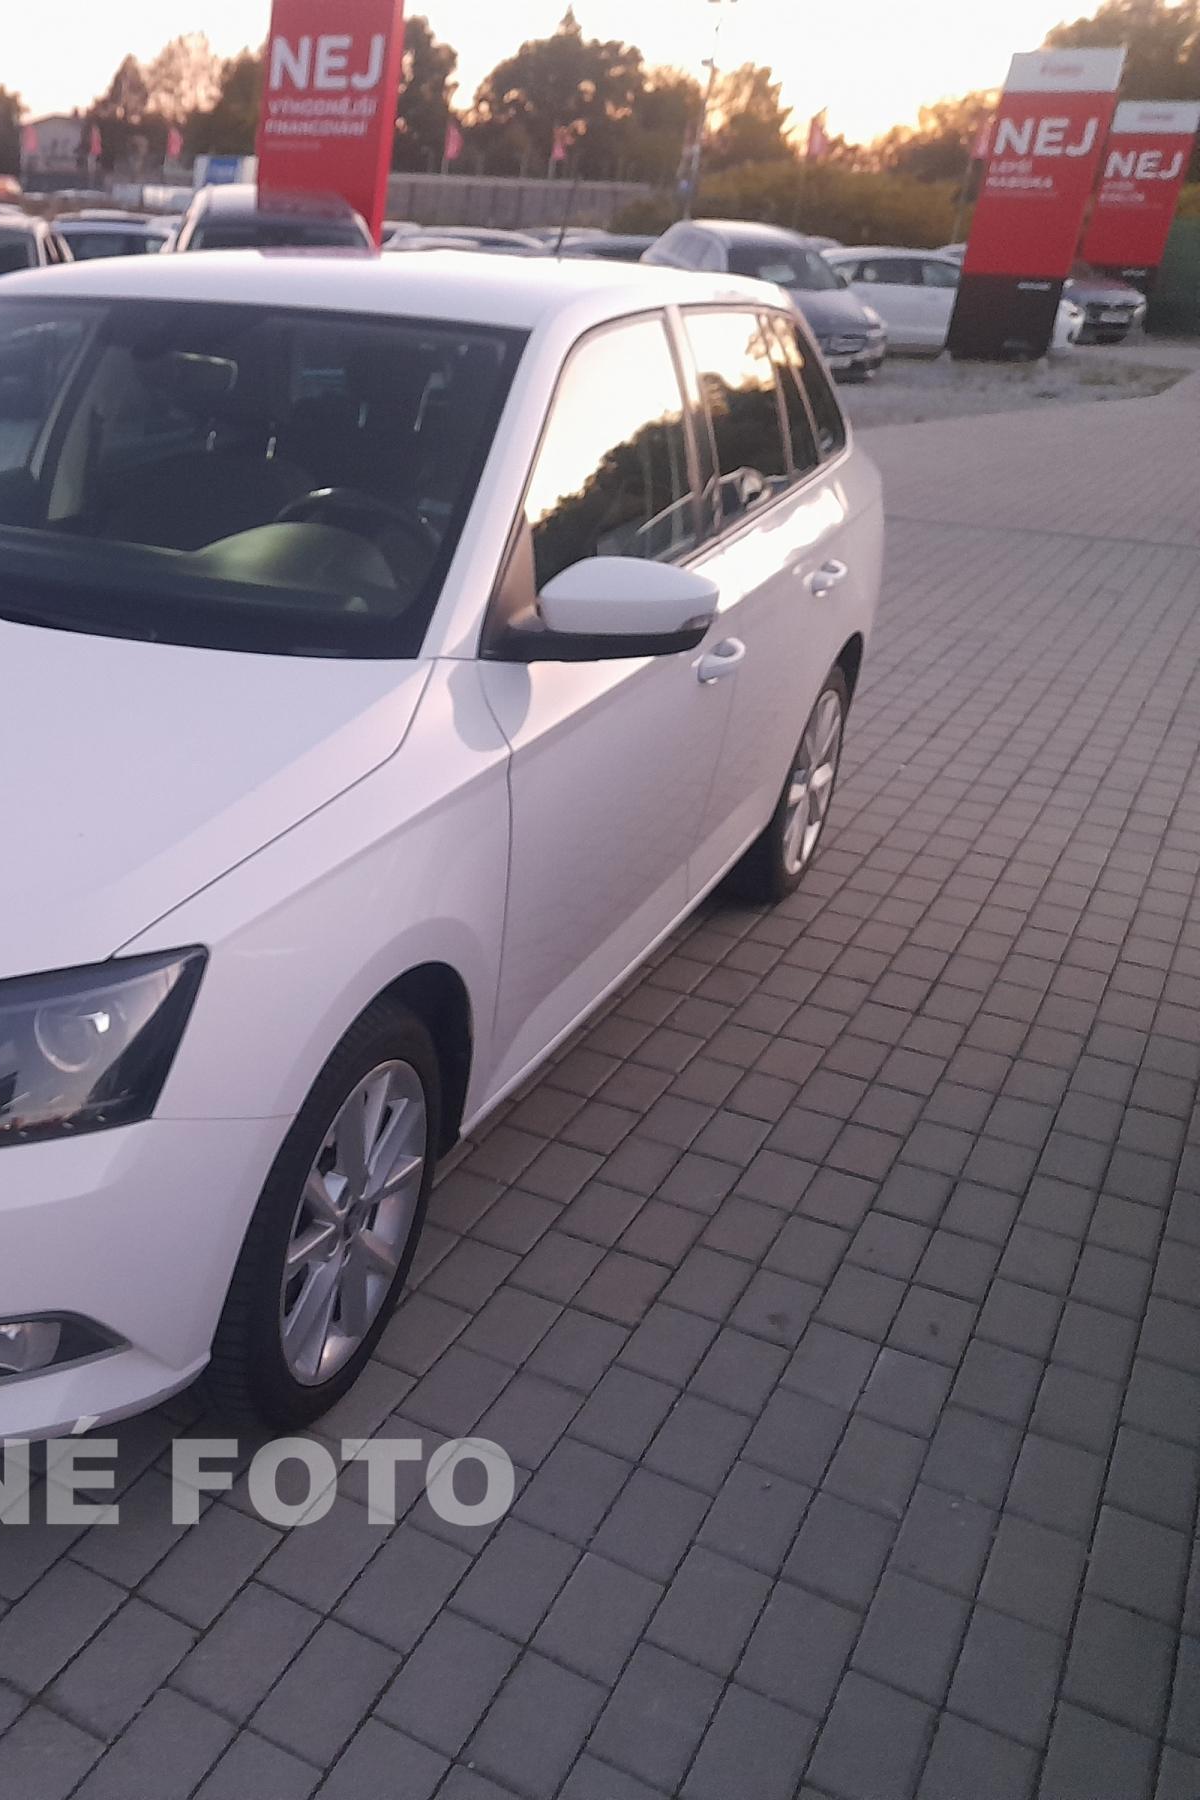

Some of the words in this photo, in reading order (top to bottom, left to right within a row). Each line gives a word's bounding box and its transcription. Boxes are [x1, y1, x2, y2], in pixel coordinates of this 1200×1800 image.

[269, 34, 385, 90] NEJ
[993, 116, 1099, 157] NEJ
[1104, 150, 1184, 180] NEJ
